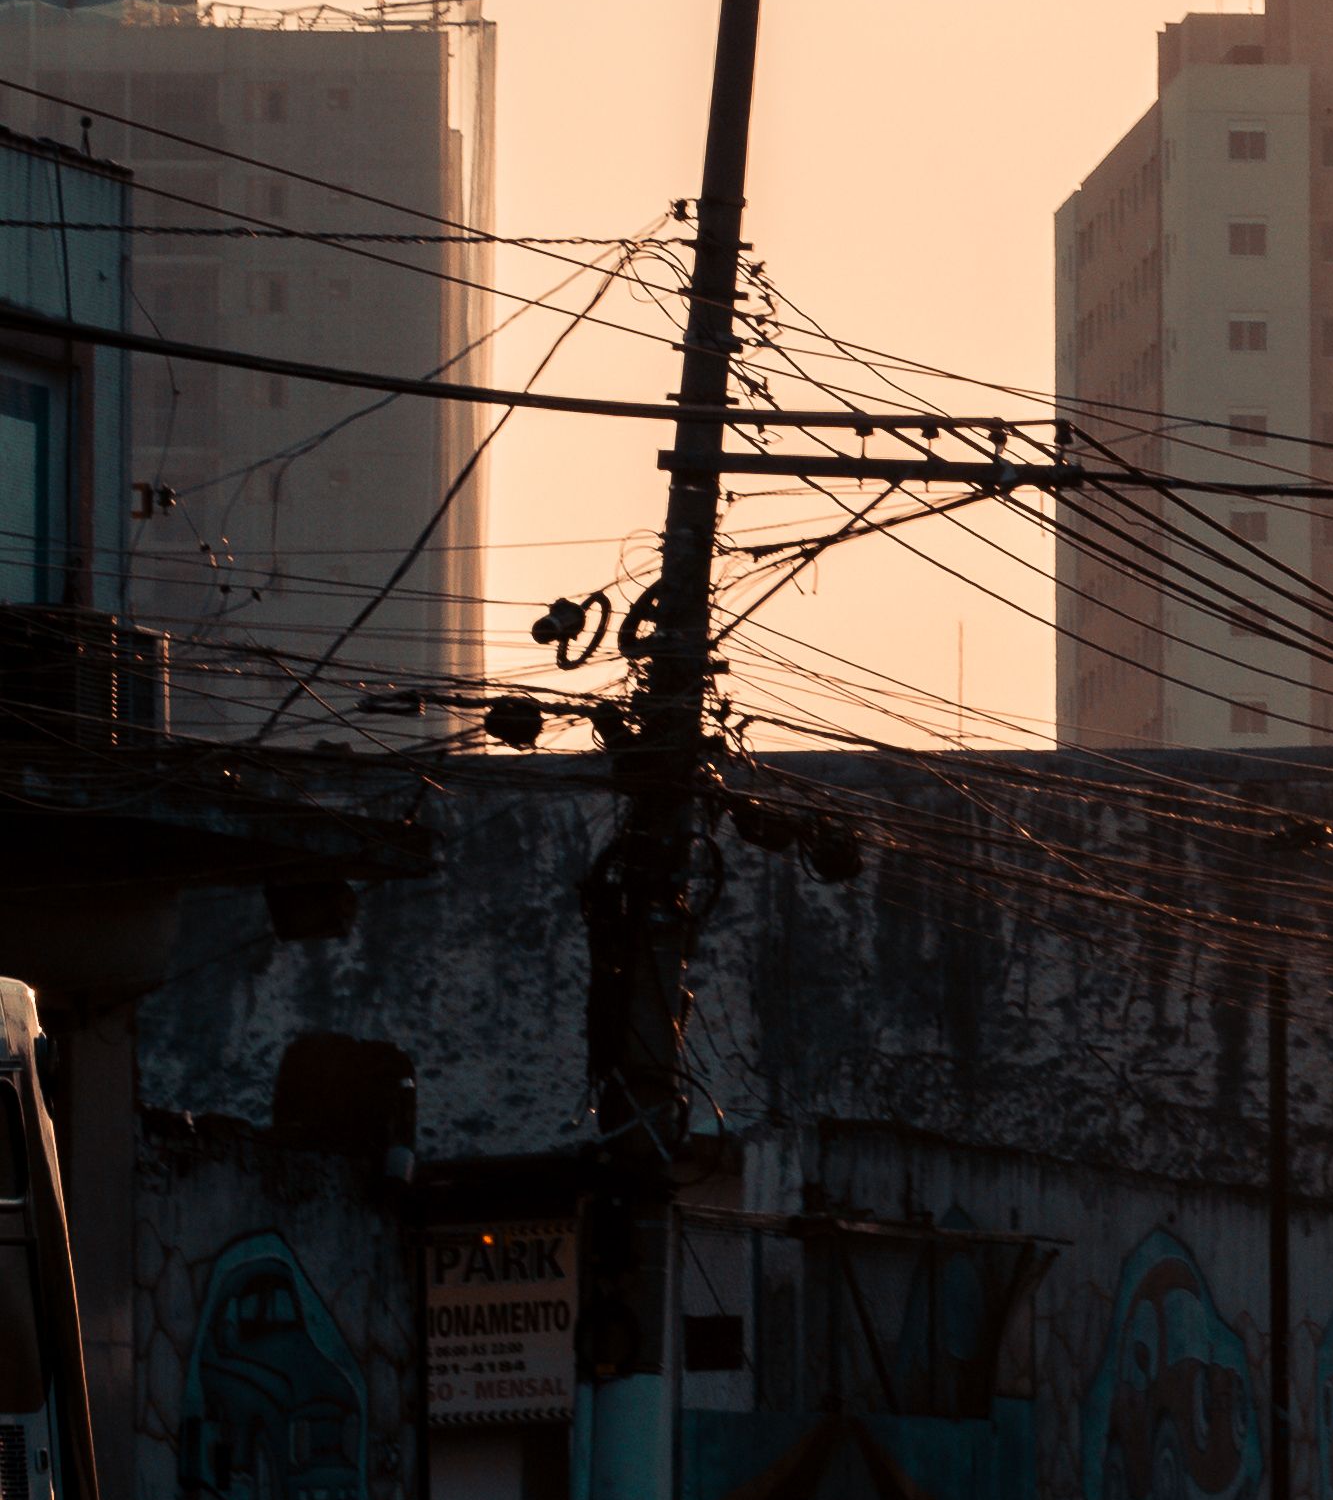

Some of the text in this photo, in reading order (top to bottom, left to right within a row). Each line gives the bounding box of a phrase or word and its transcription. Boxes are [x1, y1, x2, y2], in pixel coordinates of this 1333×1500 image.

[436, 1237, 566, 1285] PARK
[428, 1300, 571, 1338] IONAMENTO
[474, 1378, 568, 1400] MENSAL
